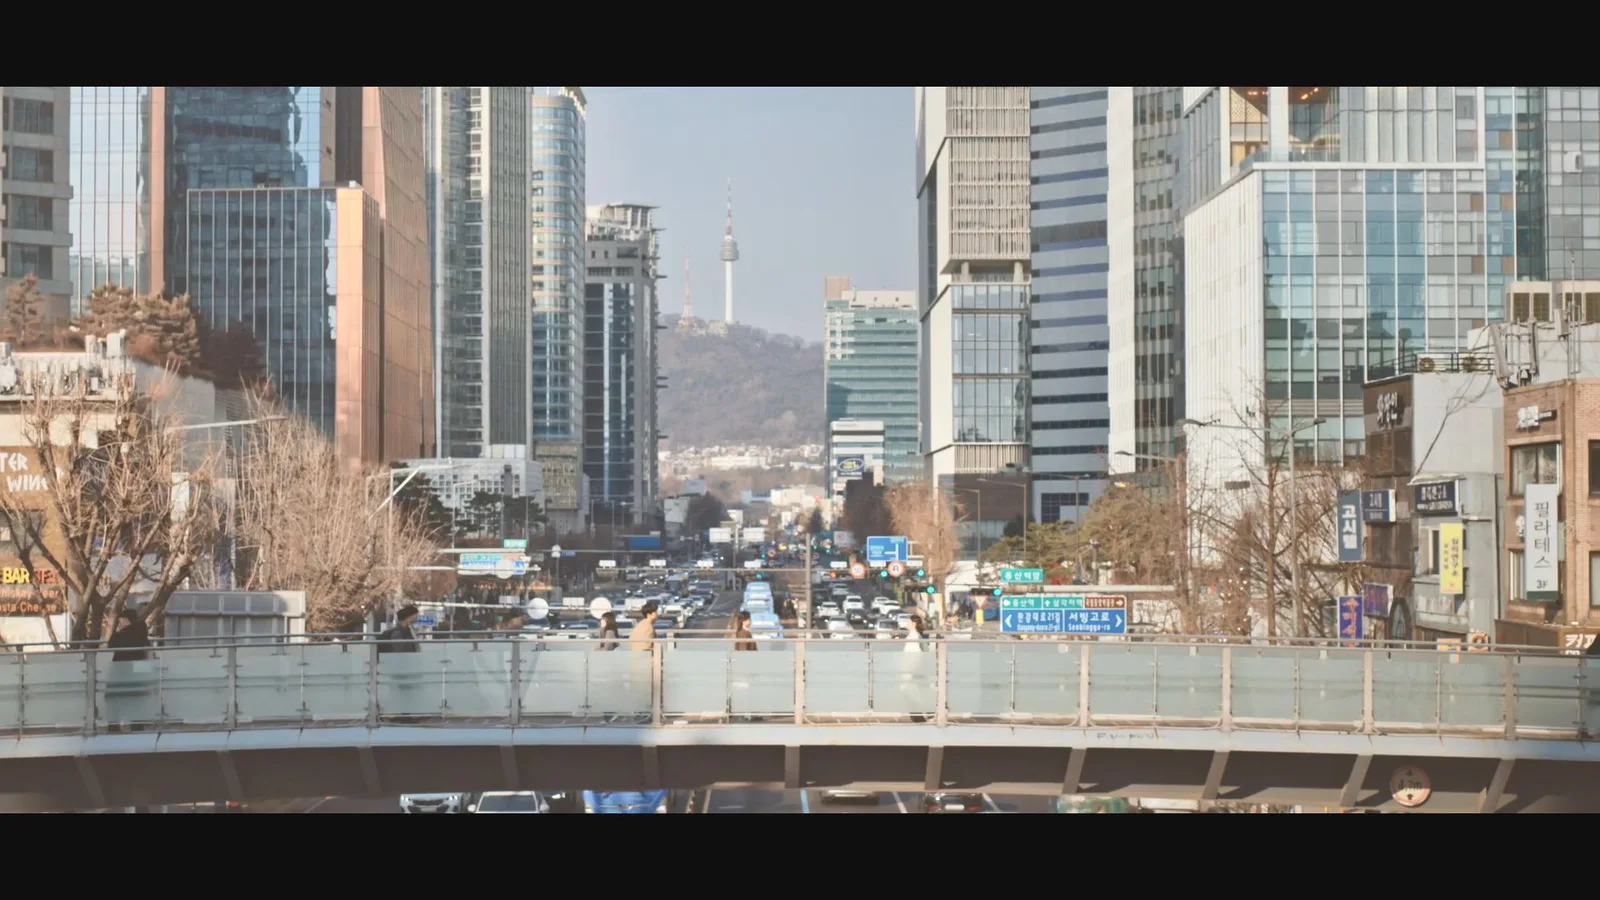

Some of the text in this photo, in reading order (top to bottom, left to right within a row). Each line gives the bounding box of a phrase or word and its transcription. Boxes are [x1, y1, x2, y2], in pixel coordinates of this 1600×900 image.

[1533, 501, 1551, 569] 필라테스
[2, 567, 30, 584] BAR
[1536, 579, 1549, 589] 3F
[1069, 612, 1111, 623] 서빙고로
